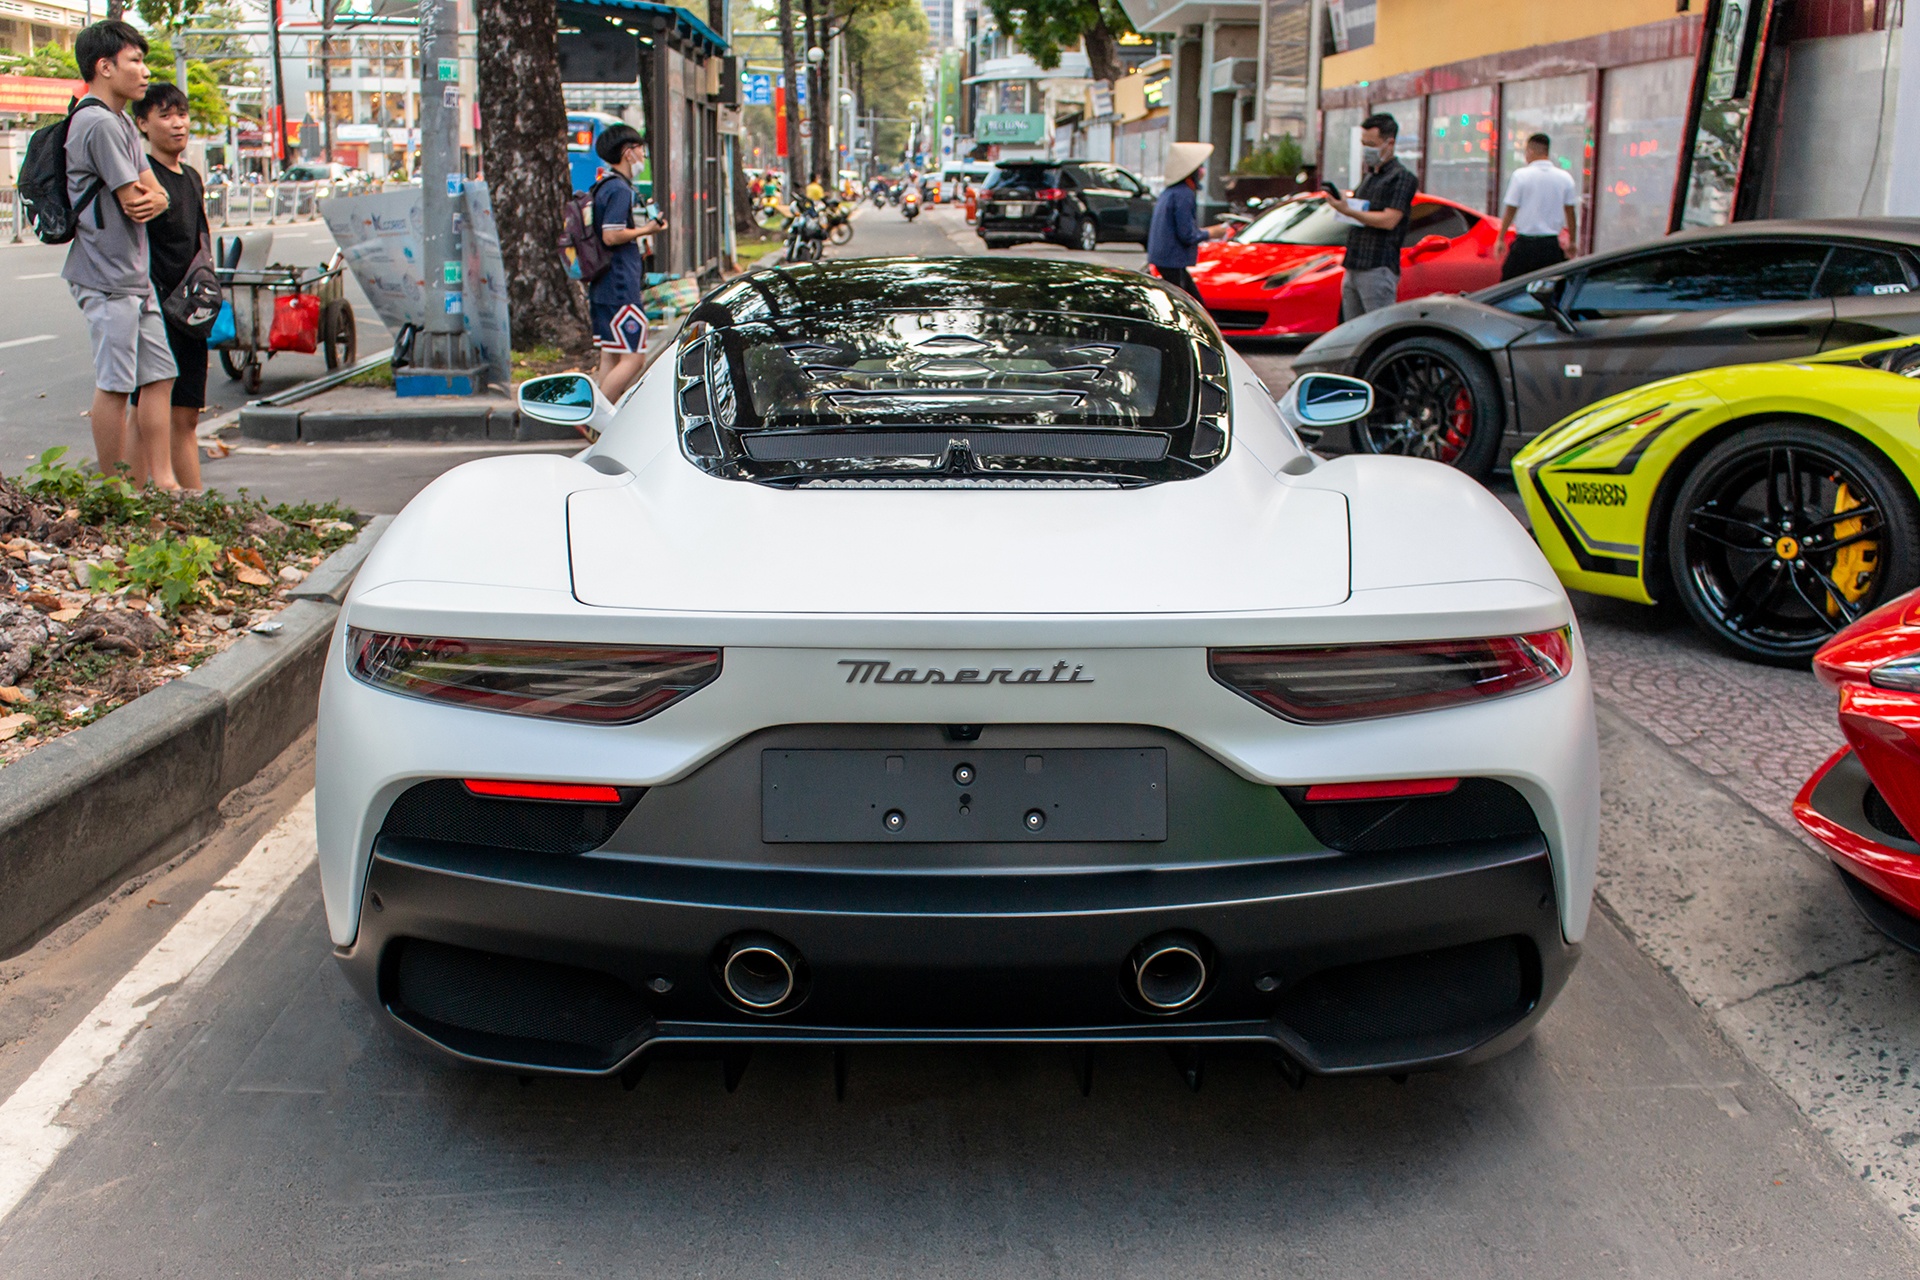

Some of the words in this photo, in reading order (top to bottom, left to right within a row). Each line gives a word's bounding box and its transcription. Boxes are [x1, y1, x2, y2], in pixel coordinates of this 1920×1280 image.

[1566, 482, 1626, 495] MISSION
[1566, 492, 1627, 506] WINNOW
[837, 659, 1096, 684] Maserati
